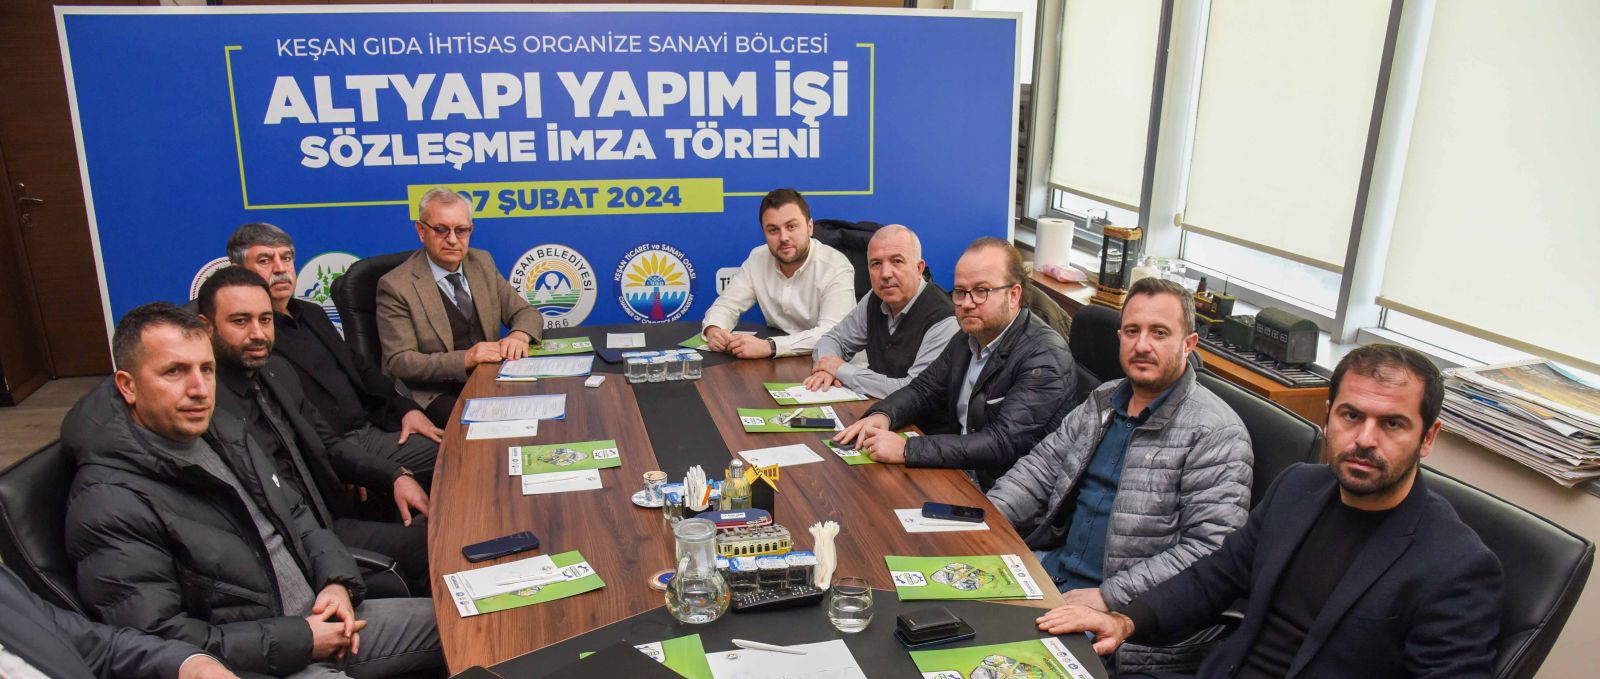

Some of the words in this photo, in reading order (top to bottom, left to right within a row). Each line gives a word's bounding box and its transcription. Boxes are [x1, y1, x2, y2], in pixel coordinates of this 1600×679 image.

[276, 37, 355, 61] KEŞAN
[363, 36, 422, 55] GIDA
[428, 31, 517, 55] İHTİSAS
[522, 30, 642, 54] ORGANİZE
[648, 31, 727, 53] SANAYİ
[735, 32, 828, 54] BÖLGESİ
[263, 71, 542, 125] ALTYAPI
[556, 70, 758, 119] YAPIM
[775, 60, 849, 122] İŞİ
[300, 128, 537, 171] SÖZLEŞME
[546, 122, 656, 162] İMZA
[664, 120, 820, 160] TÖRENİ
[497, 187, 599, 215] ŞUBAT
[606, 185, 683, 209] 2024
[536, 247, 594, 292] BELEDİYESİ
